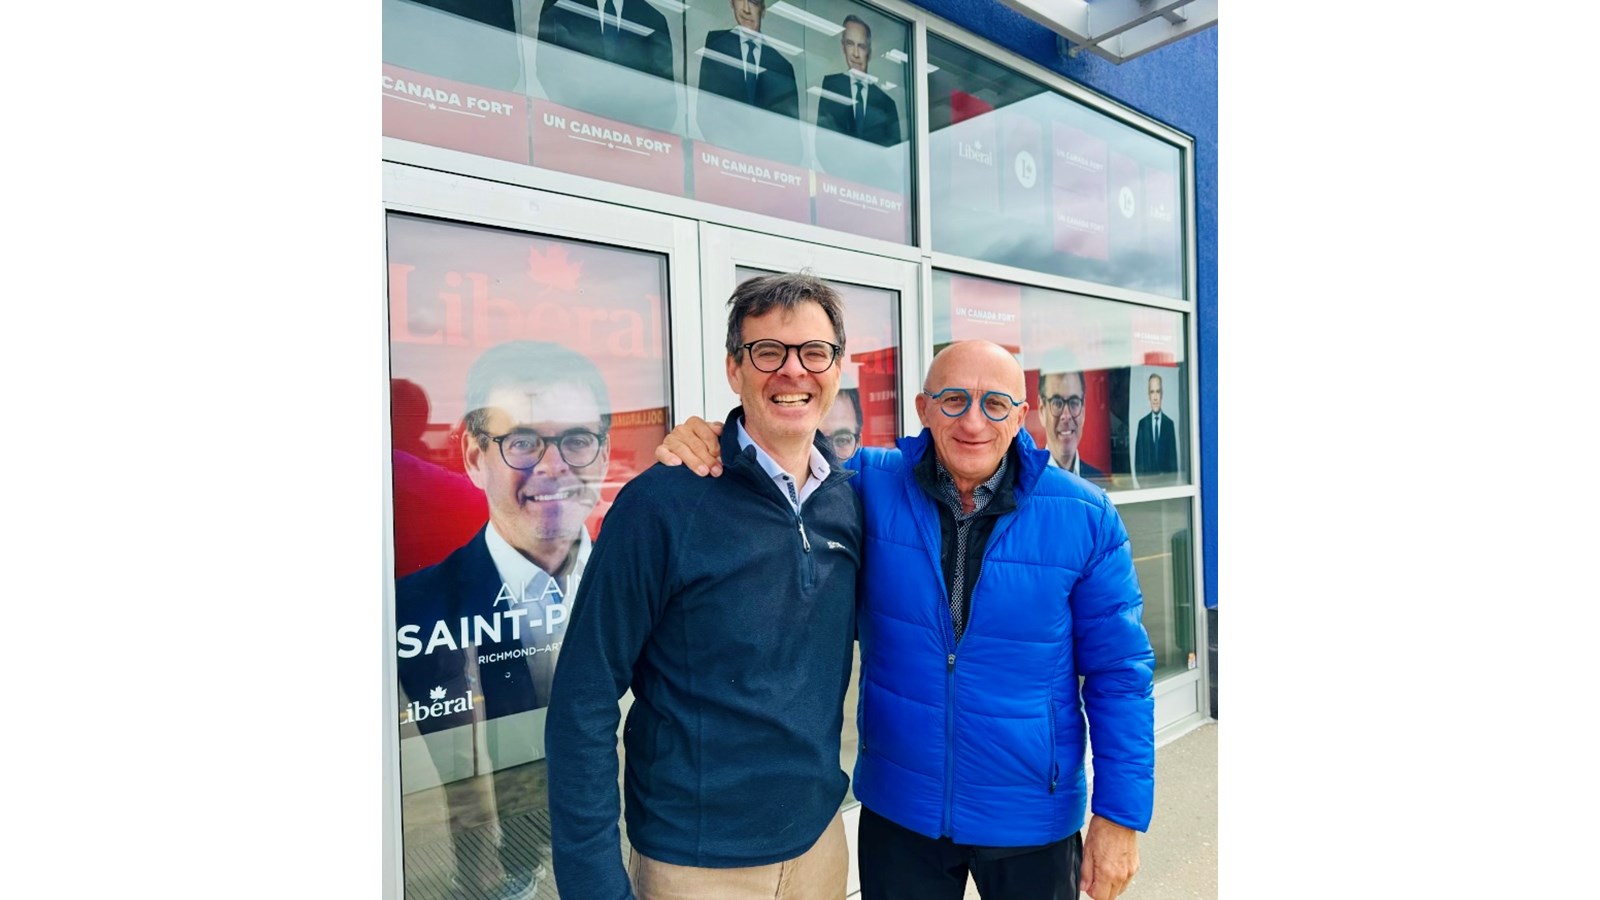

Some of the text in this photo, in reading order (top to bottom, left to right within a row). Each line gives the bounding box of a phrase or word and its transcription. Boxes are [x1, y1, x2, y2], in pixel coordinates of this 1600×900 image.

[382, 75, 513, 116] CANADA FORT
[543, 112, 672, 154] UN CANADA FORT
[702, 152, 802, 186] UN CANADA FORT
[823, 183, 903, 212] UN CANADA FORT
[389, 262, 663, 359] Libéral
[955, 307, 1016, 323] UN CANADA FORT
[397, 602, 574, 659] SAINT-P
[400, 690, 475, 725] ibéral
